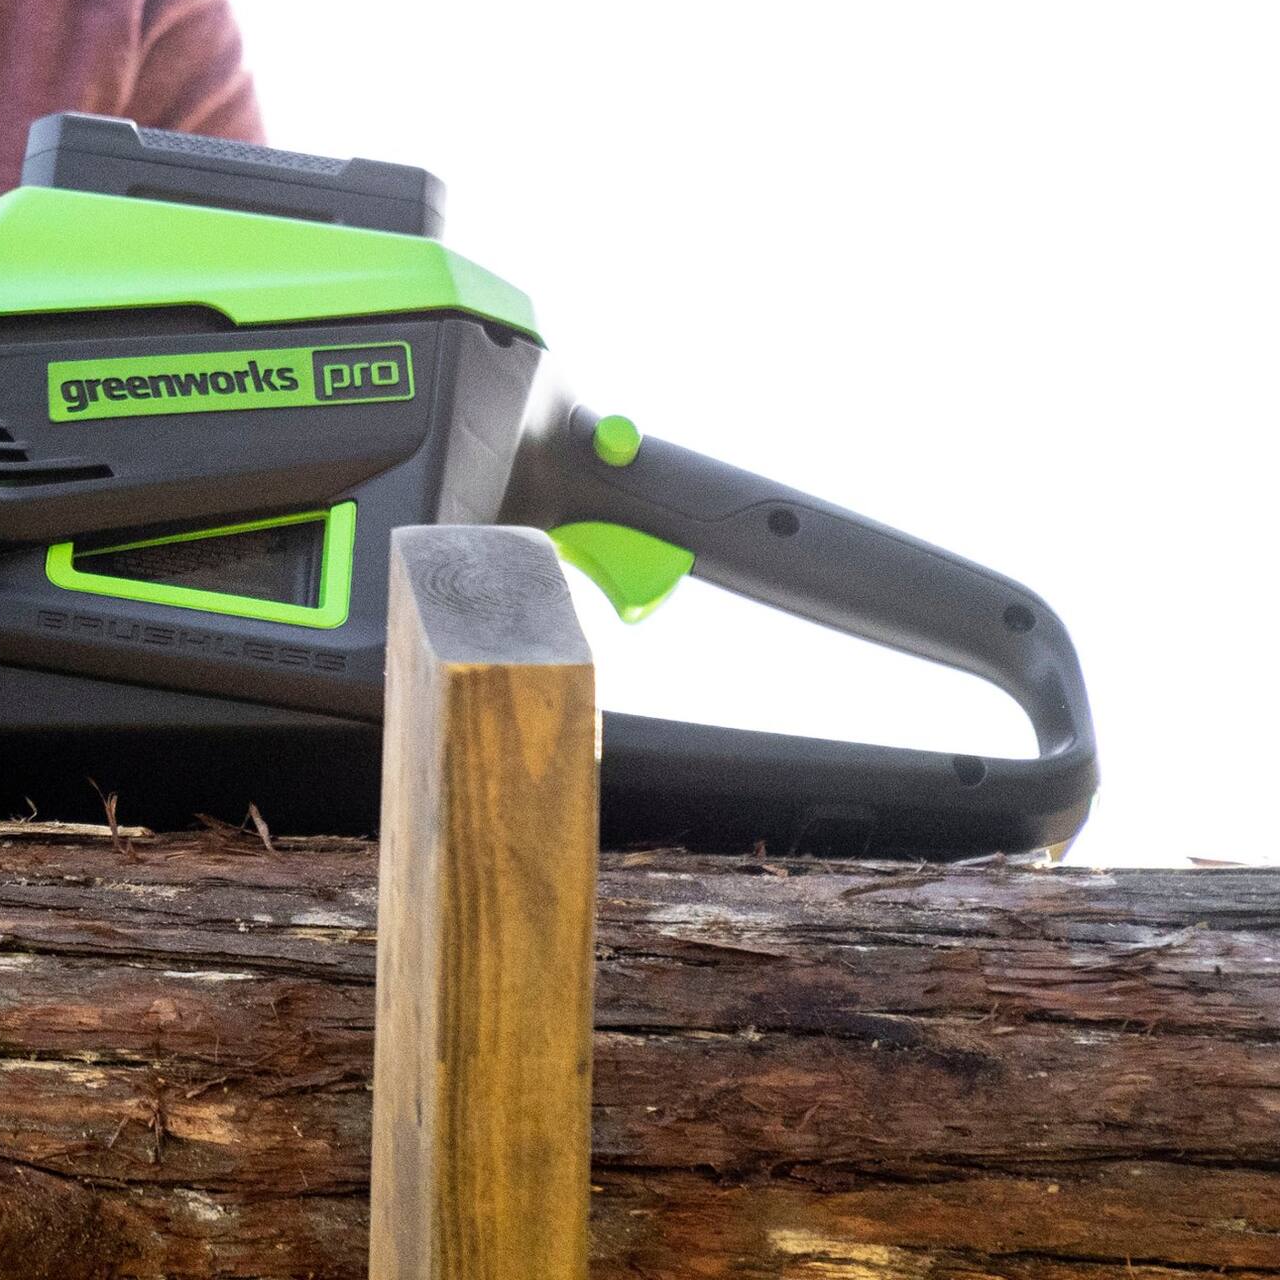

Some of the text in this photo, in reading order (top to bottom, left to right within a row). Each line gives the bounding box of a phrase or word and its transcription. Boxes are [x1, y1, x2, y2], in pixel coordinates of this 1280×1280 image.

[59, 360, 400, 413] greenworks pro
[38, 610, 347, 671] BRUSHLESS
